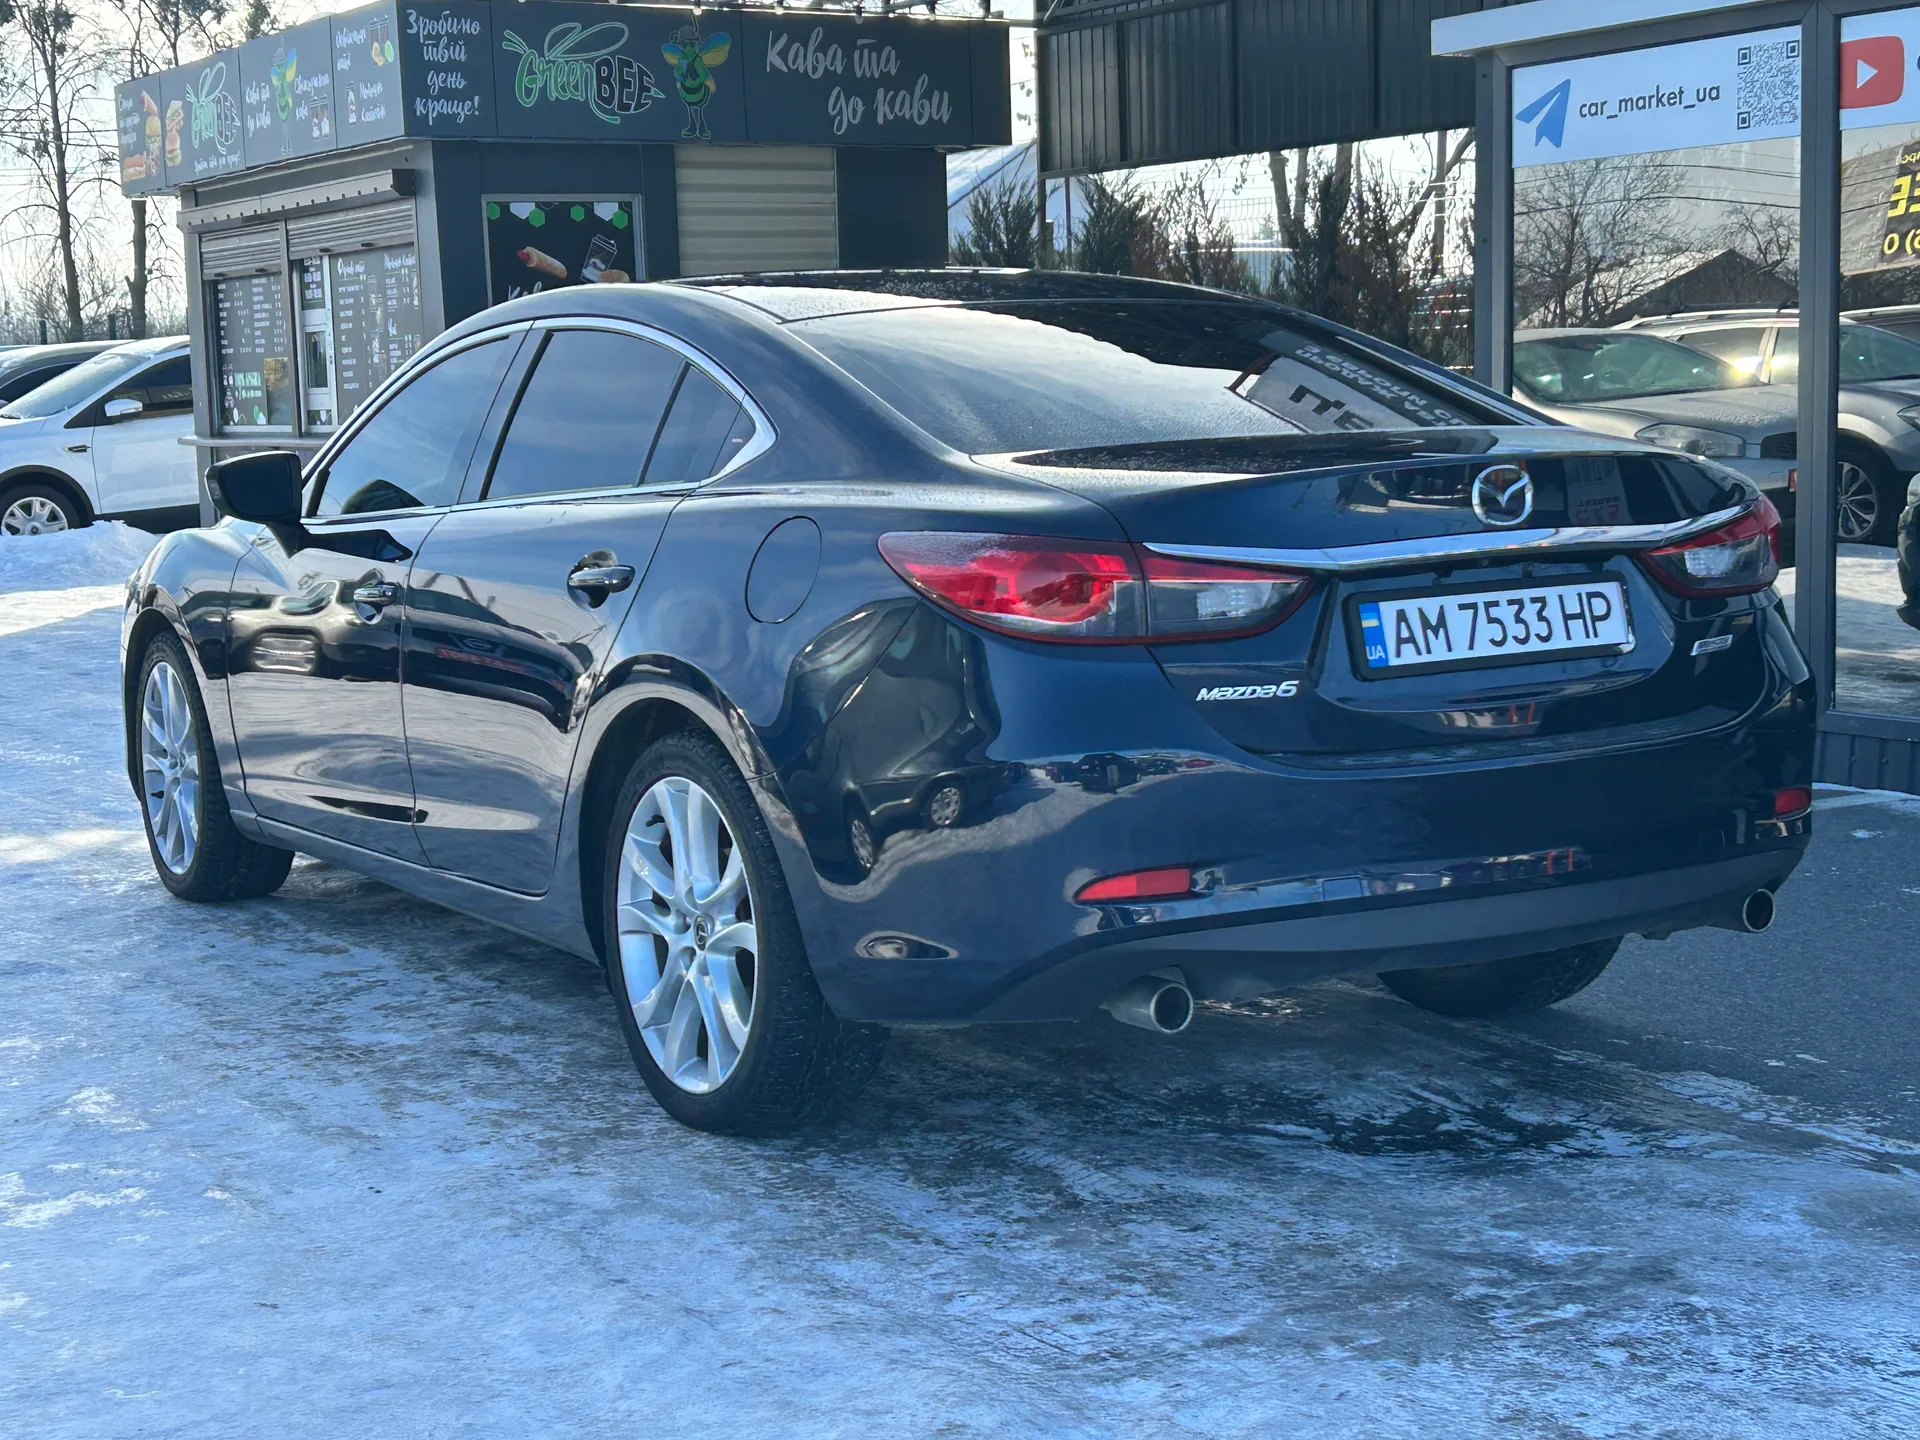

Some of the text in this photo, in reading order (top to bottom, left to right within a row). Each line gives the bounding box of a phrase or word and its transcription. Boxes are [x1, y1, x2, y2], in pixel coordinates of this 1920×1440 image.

[423, 37, 468, 63] твій
[766, 26, 900, 79] Кава та
[427, 70, 467, 95] день
[414, 96, 480, 125] краще!
[828, 73, 952, 135] до кави
[1579, 84, 1720, 119] car_market_ua
[1394, 590, 1612, 658] AM 7533 HP
[1365, 645, 1385, 660] UA
